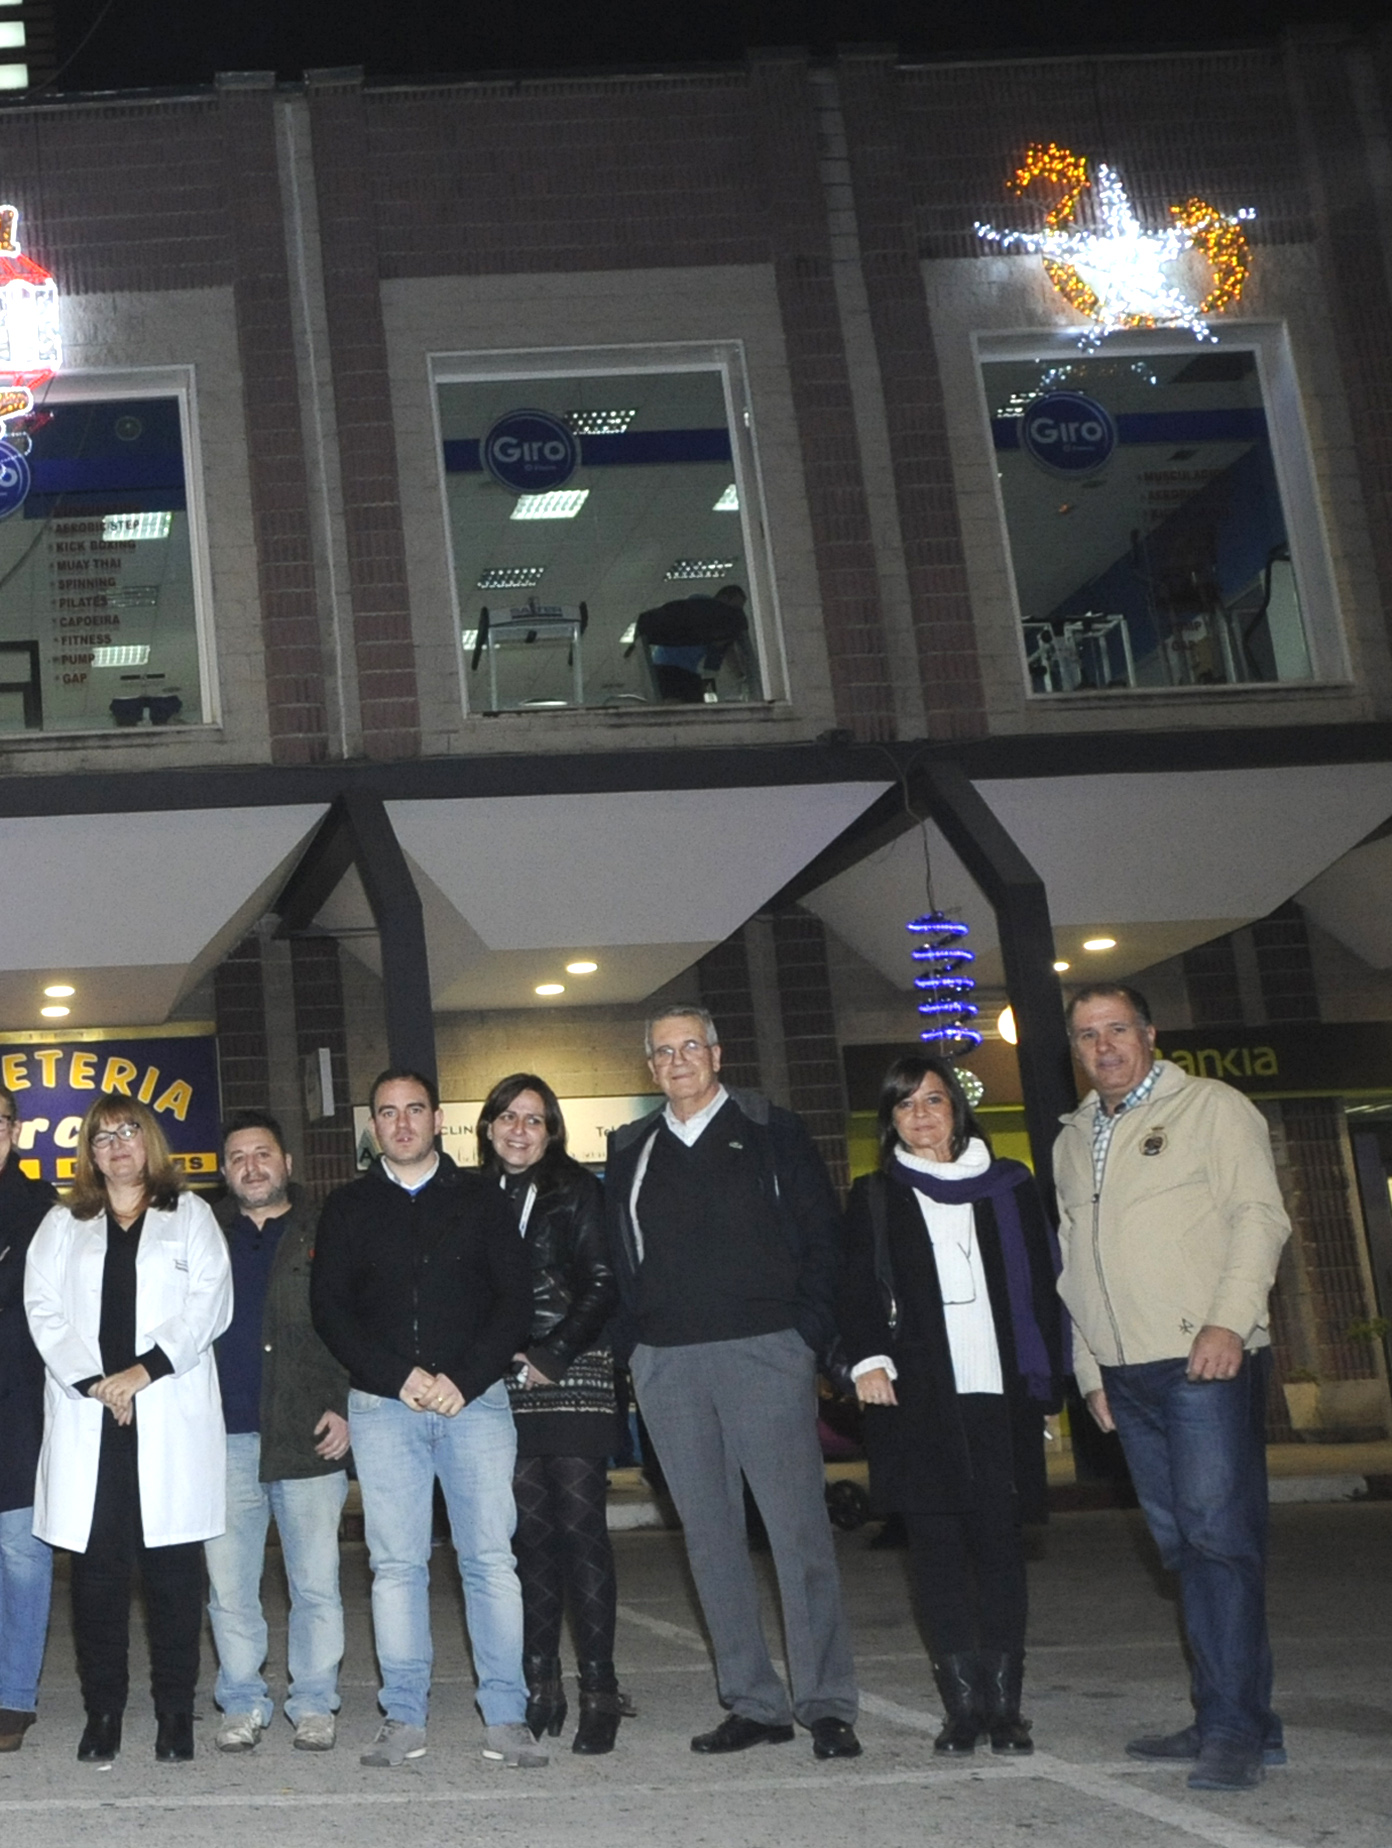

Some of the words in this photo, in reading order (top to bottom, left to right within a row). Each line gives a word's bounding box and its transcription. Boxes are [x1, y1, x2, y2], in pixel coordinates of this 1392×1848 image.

[1029, 416, 1103, 444] Giro
[493, 436, 565, 462] Giro
[56, 542, 86, 553] KICK
[90, 540, 137, 552] BOXING
[57, 560, 89, 571] MUAY
[94, 558, 121, 569] THAI
[58, 578, 117, 590] SPINNING
[59, 597, 109, 609] PILATES
[59, 614, 120, 628] CAPOEIRA
[61, 634, 112, 646] FITNESS
[61, 653, 95, 665] PUMP
[62, 673, 87, 684] GAP
[1154, 1046, 1278, 1077] ankia
[440, 1125, 474, 1136] CLIN
